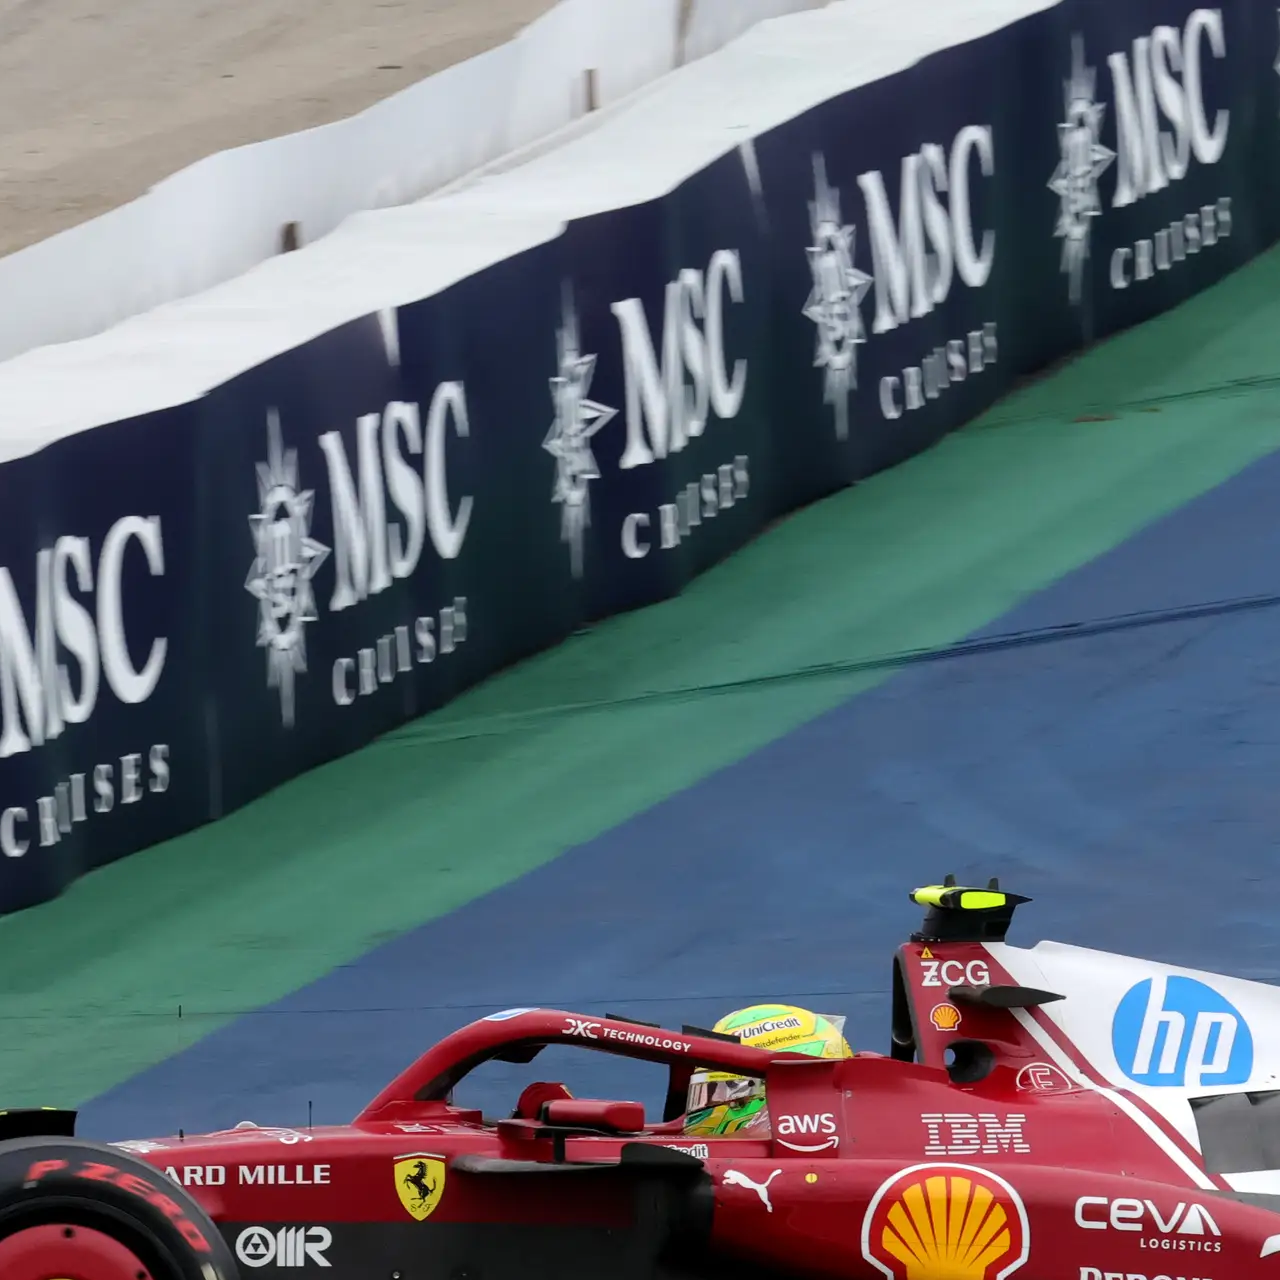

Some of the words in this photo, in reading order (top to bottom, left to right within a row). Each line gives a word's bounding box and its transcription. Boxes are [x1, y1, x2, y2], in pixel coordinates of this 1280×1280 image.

[1107, 8, 1229, 207] MSC
[857, 125, 995, 333] MSC
[611, 249, 748, 469] MSC
[319, 381, 474, 611] MSC
[562, 1018, 602, 1039] DXC
[603, 1027, 691, 1052] TECHNOLOGY
[742, 1017, 801, 1039] UniCredit
[1124, 975, 1239, 1087] hp
[777, 1113, 837, 1135] aws
[921, 1113, 1030, 1155] IBM
[239, 1165, 331, 1185] MILLE
[1140, 1238, 1222, 1252] LOGISTICS
